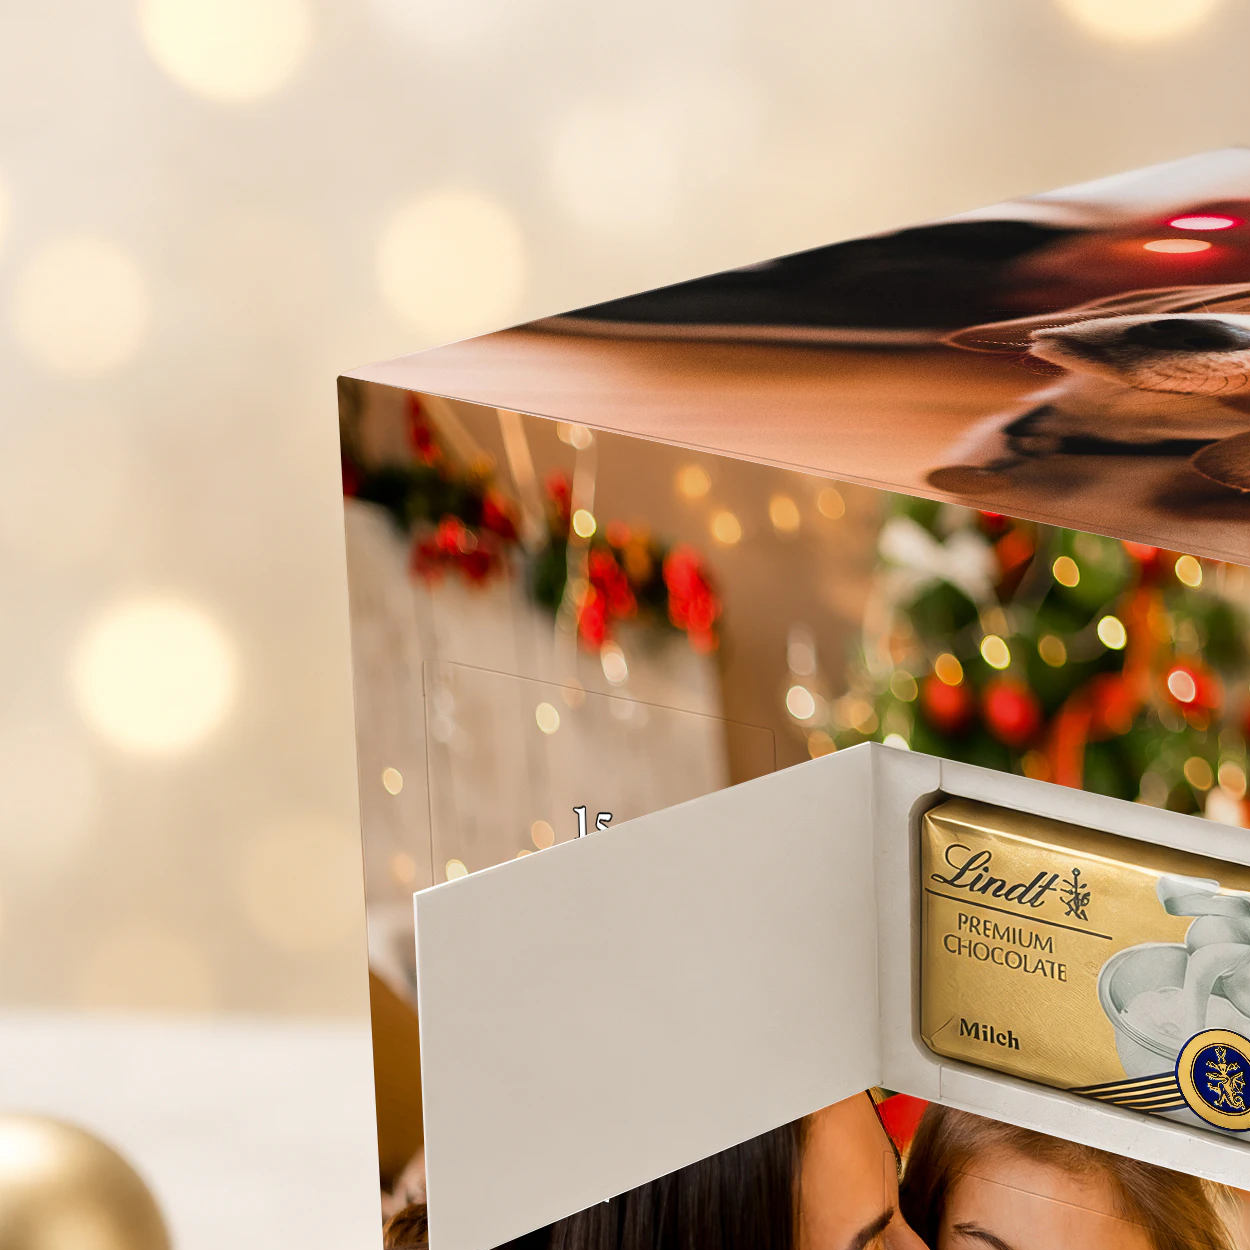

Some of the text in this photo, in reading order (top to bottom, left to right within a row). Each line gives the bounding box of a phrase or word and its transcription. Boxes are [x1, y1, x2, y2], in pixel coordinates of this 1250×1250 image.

[930, 843, 1060, 908] Lindt
[958, 912, 1054, 954] PREMIUM
[943, 934, 1068, 982] CHOCOLATE
[959, 1018, 1021, 1051] Milch
